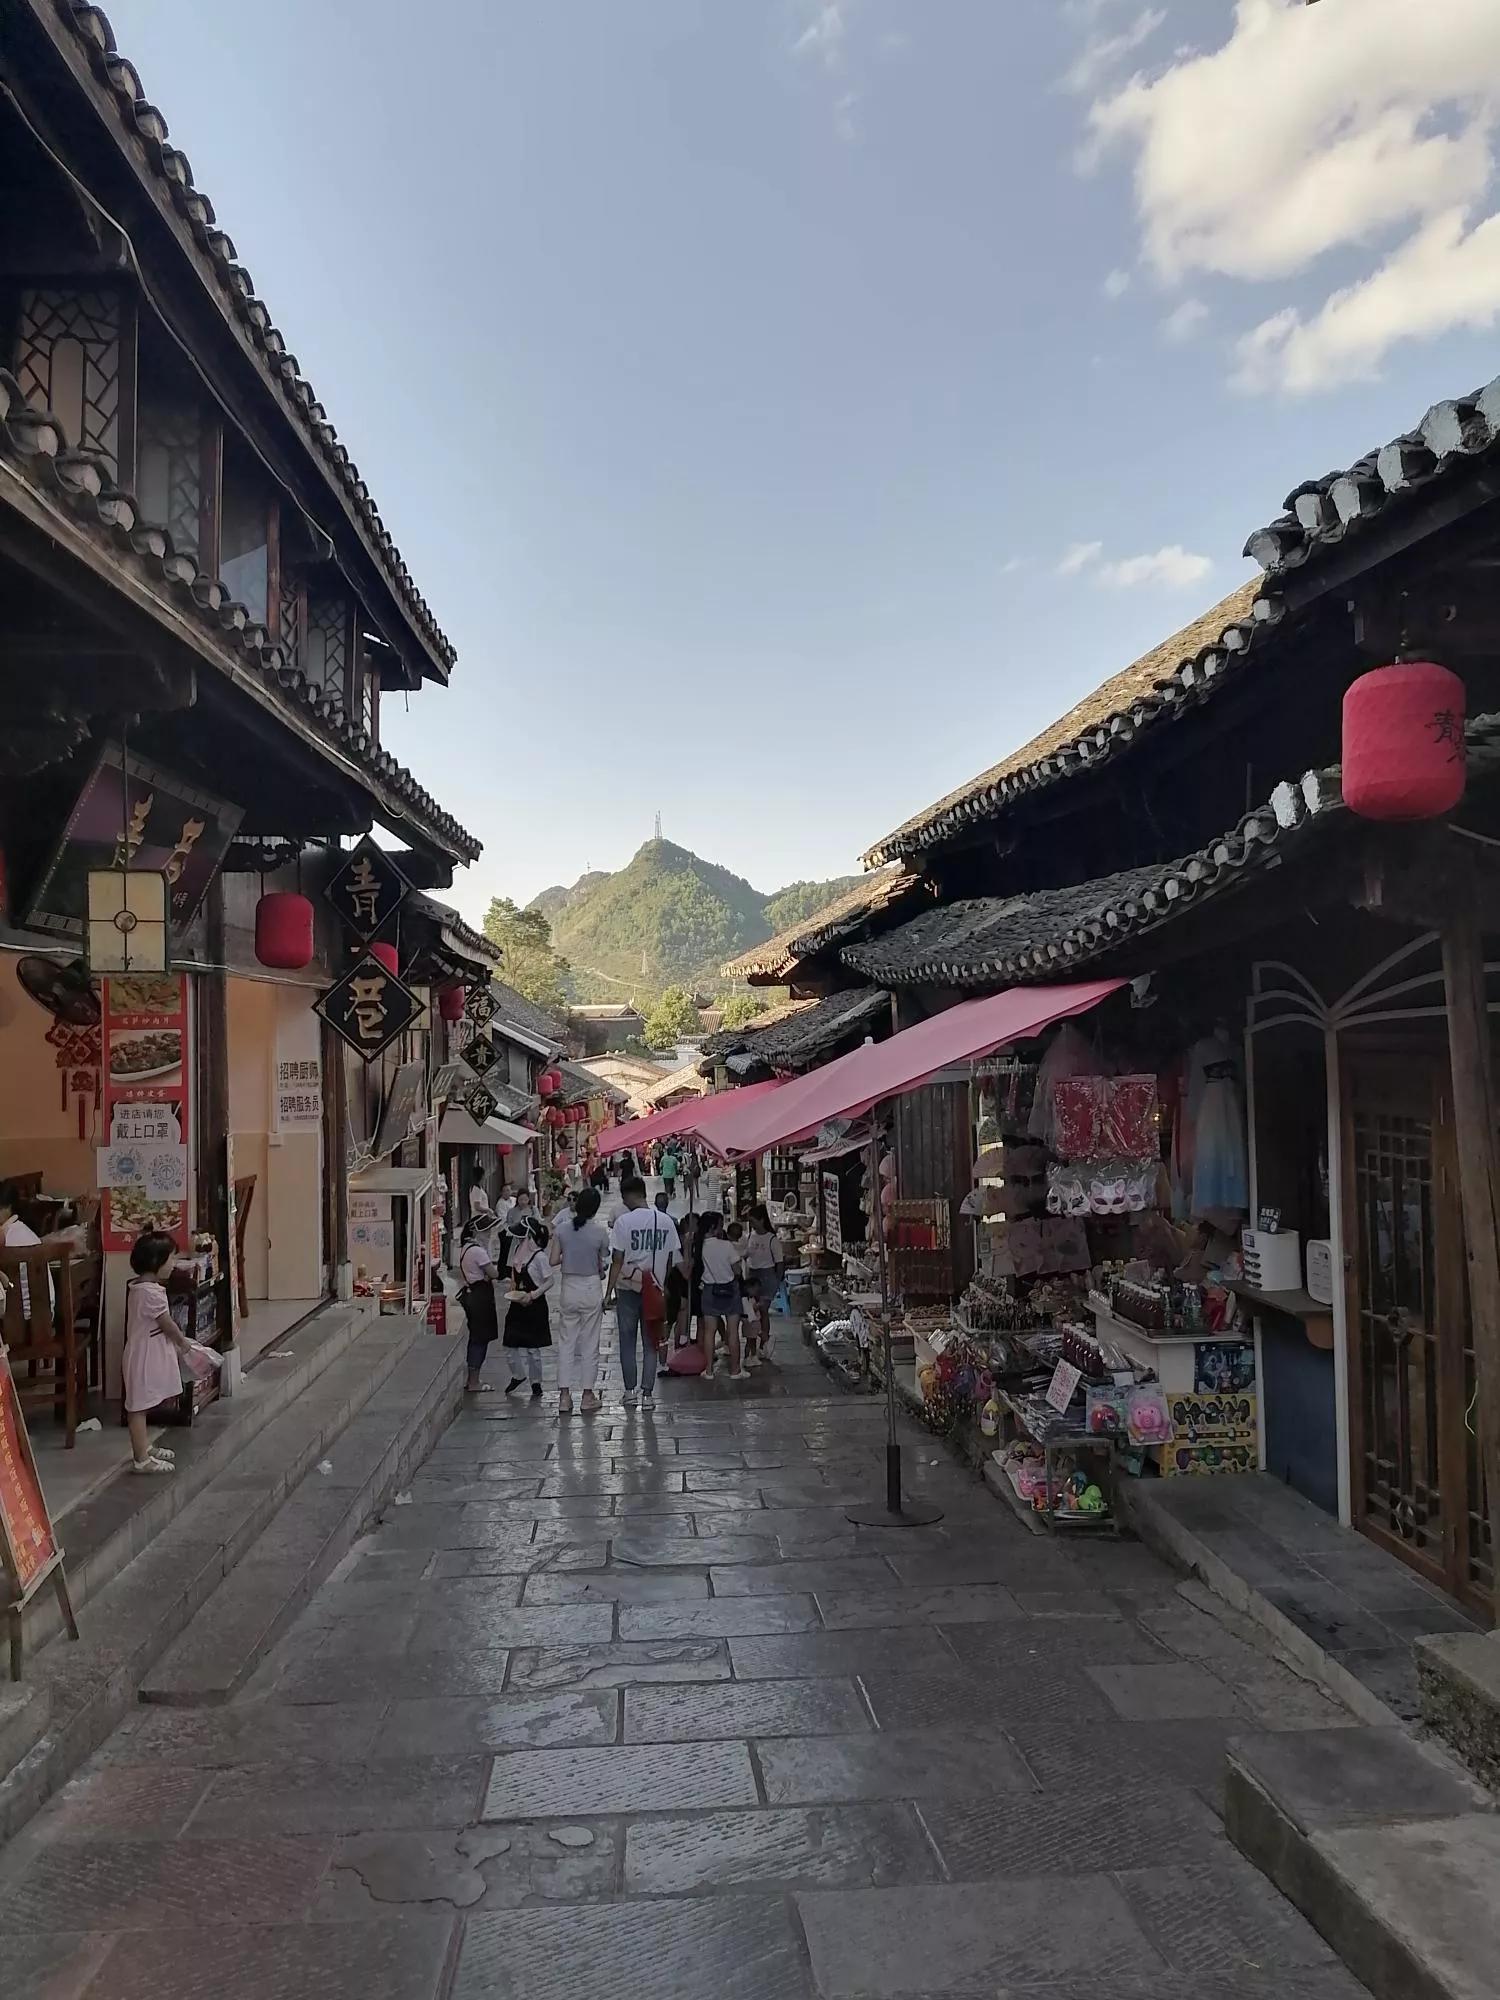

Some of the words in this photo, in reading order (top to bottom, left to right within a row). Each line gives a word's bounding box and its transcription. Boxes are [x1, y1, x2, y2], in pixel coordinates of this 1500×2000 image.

[280, 1062, 319, 1080] 招聘厨师
[280, 1095, 320, 1112] 招聘服务员
[120, 1109, 165, 1120] 进店请您
[116, 1122, 169, 1139] 戴上口罩
[631, 1229, 669, 1251] START
